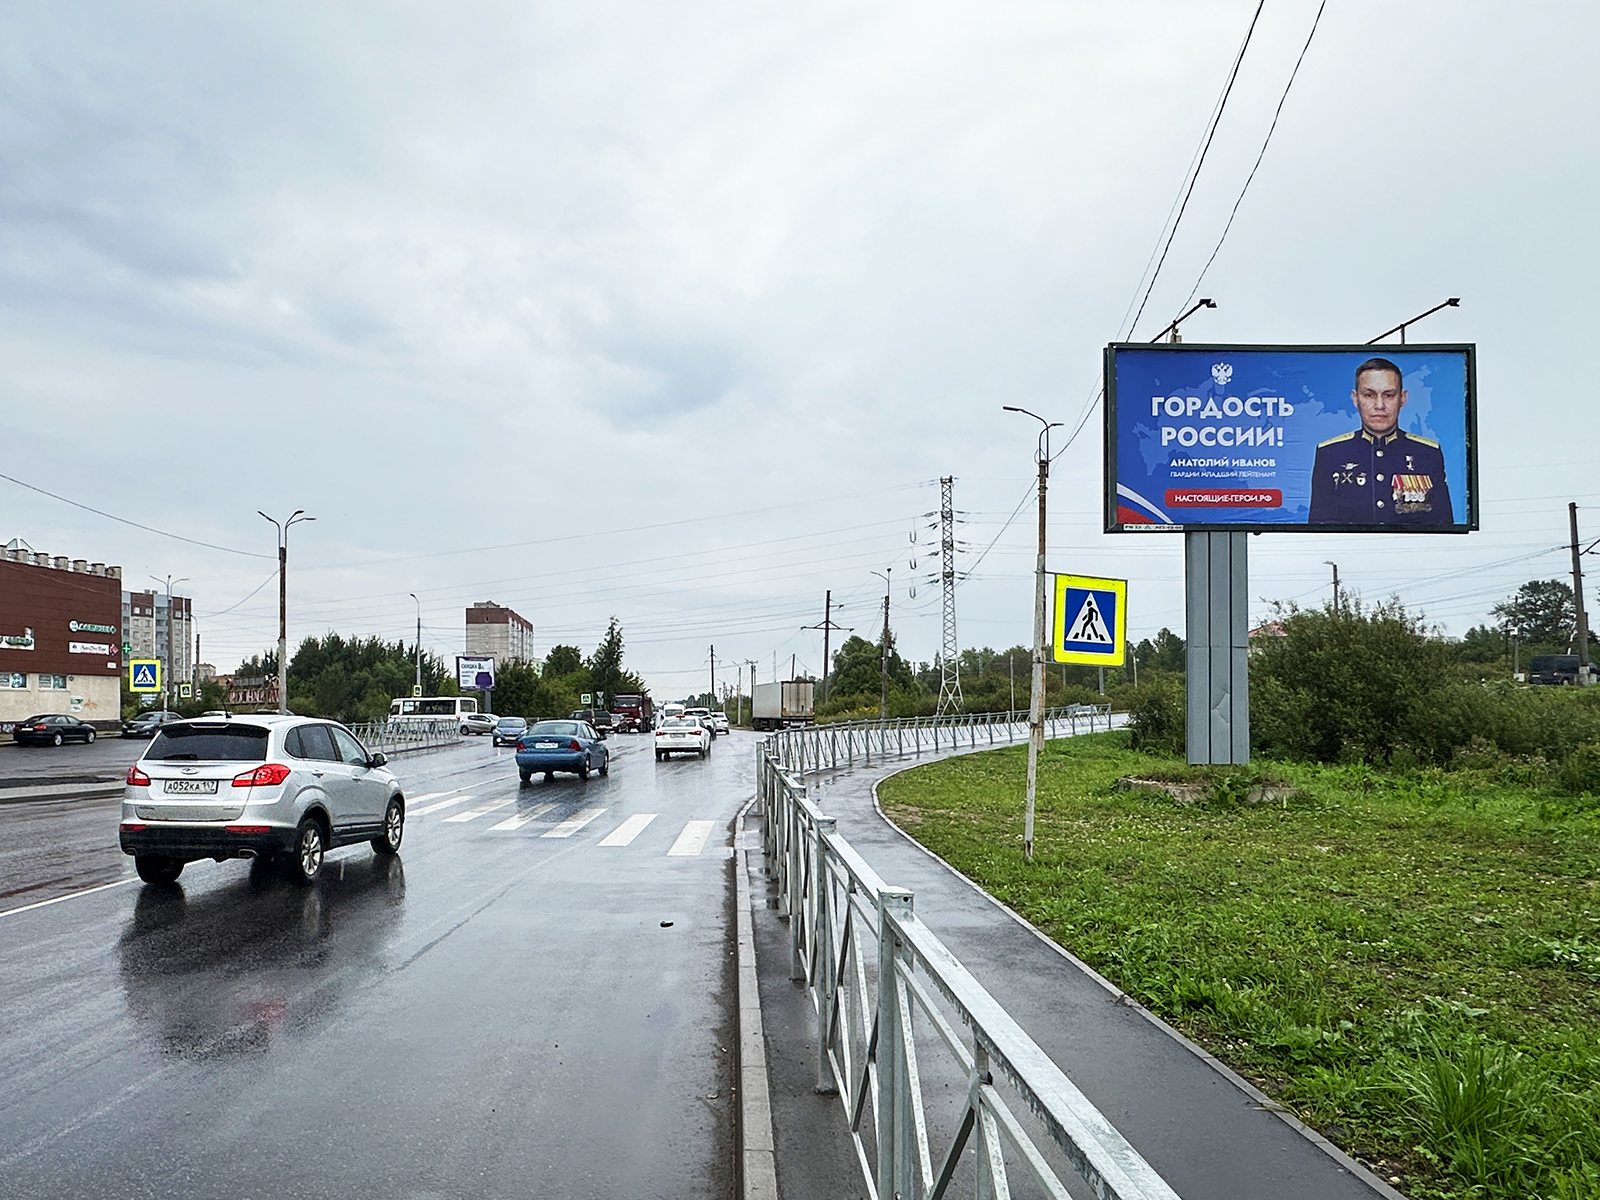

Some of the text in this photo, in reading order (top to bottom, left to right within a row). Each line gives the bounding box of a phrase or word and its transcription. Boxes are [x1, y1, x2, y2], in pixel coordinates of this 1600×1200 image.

[1151, 396, 1295, 419] ГОРДОСТЬ
[1161, 426, 1285, 447] РОССИИ!
[1170, 457, 1276, 467] АНАТОЛИЙ ИВАНОВ
[1175, 494, 1273, 503] НАСТОЯЩИЕ-ГЕРОИ.РФ
